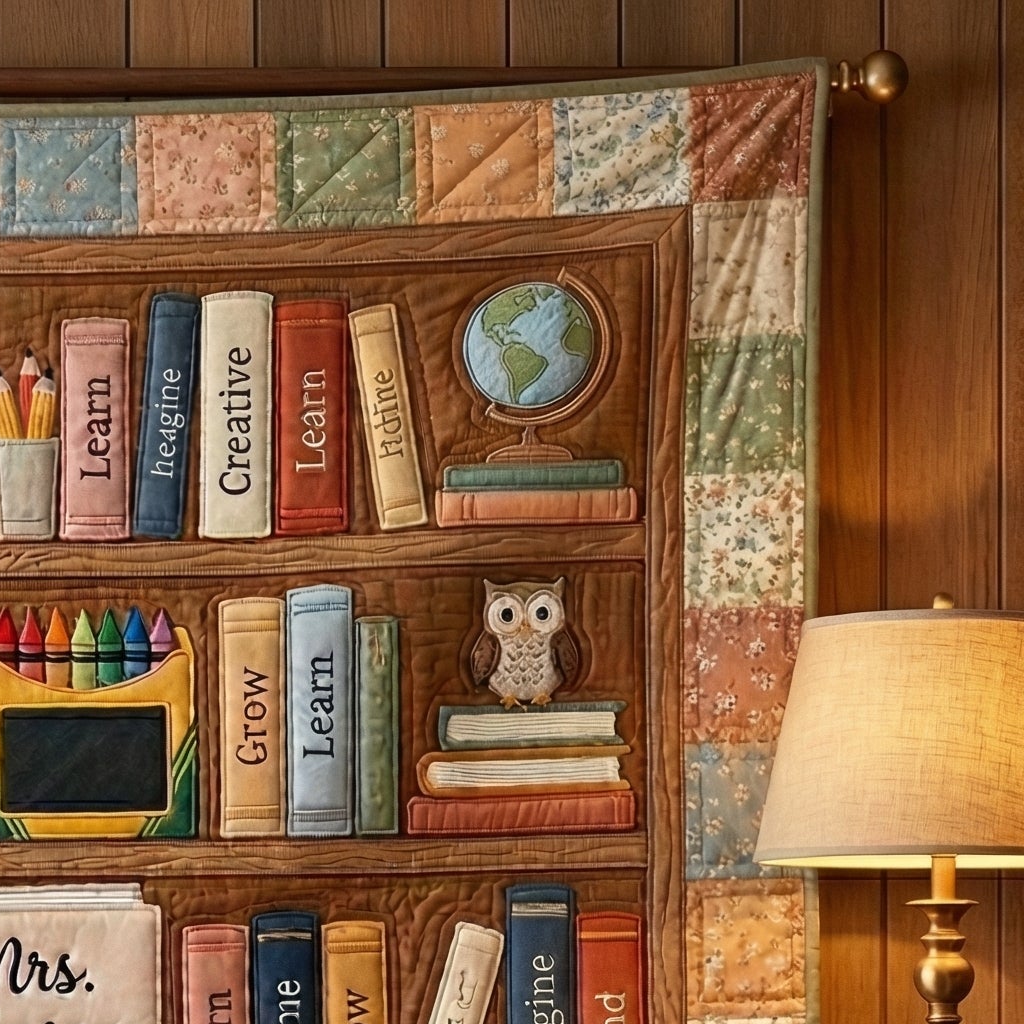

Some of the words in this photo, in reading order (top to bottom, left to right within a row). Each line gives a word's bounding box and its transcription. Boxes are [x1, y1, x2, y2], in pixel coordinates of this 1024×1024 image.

[79, 374, 111, 480] Learn
[218, 346, 252, 495] Creative
[295, 368, 327, 474] Learn
[235, 666, 269, 765] Grow
[302, 651, 335, 759] Learn
